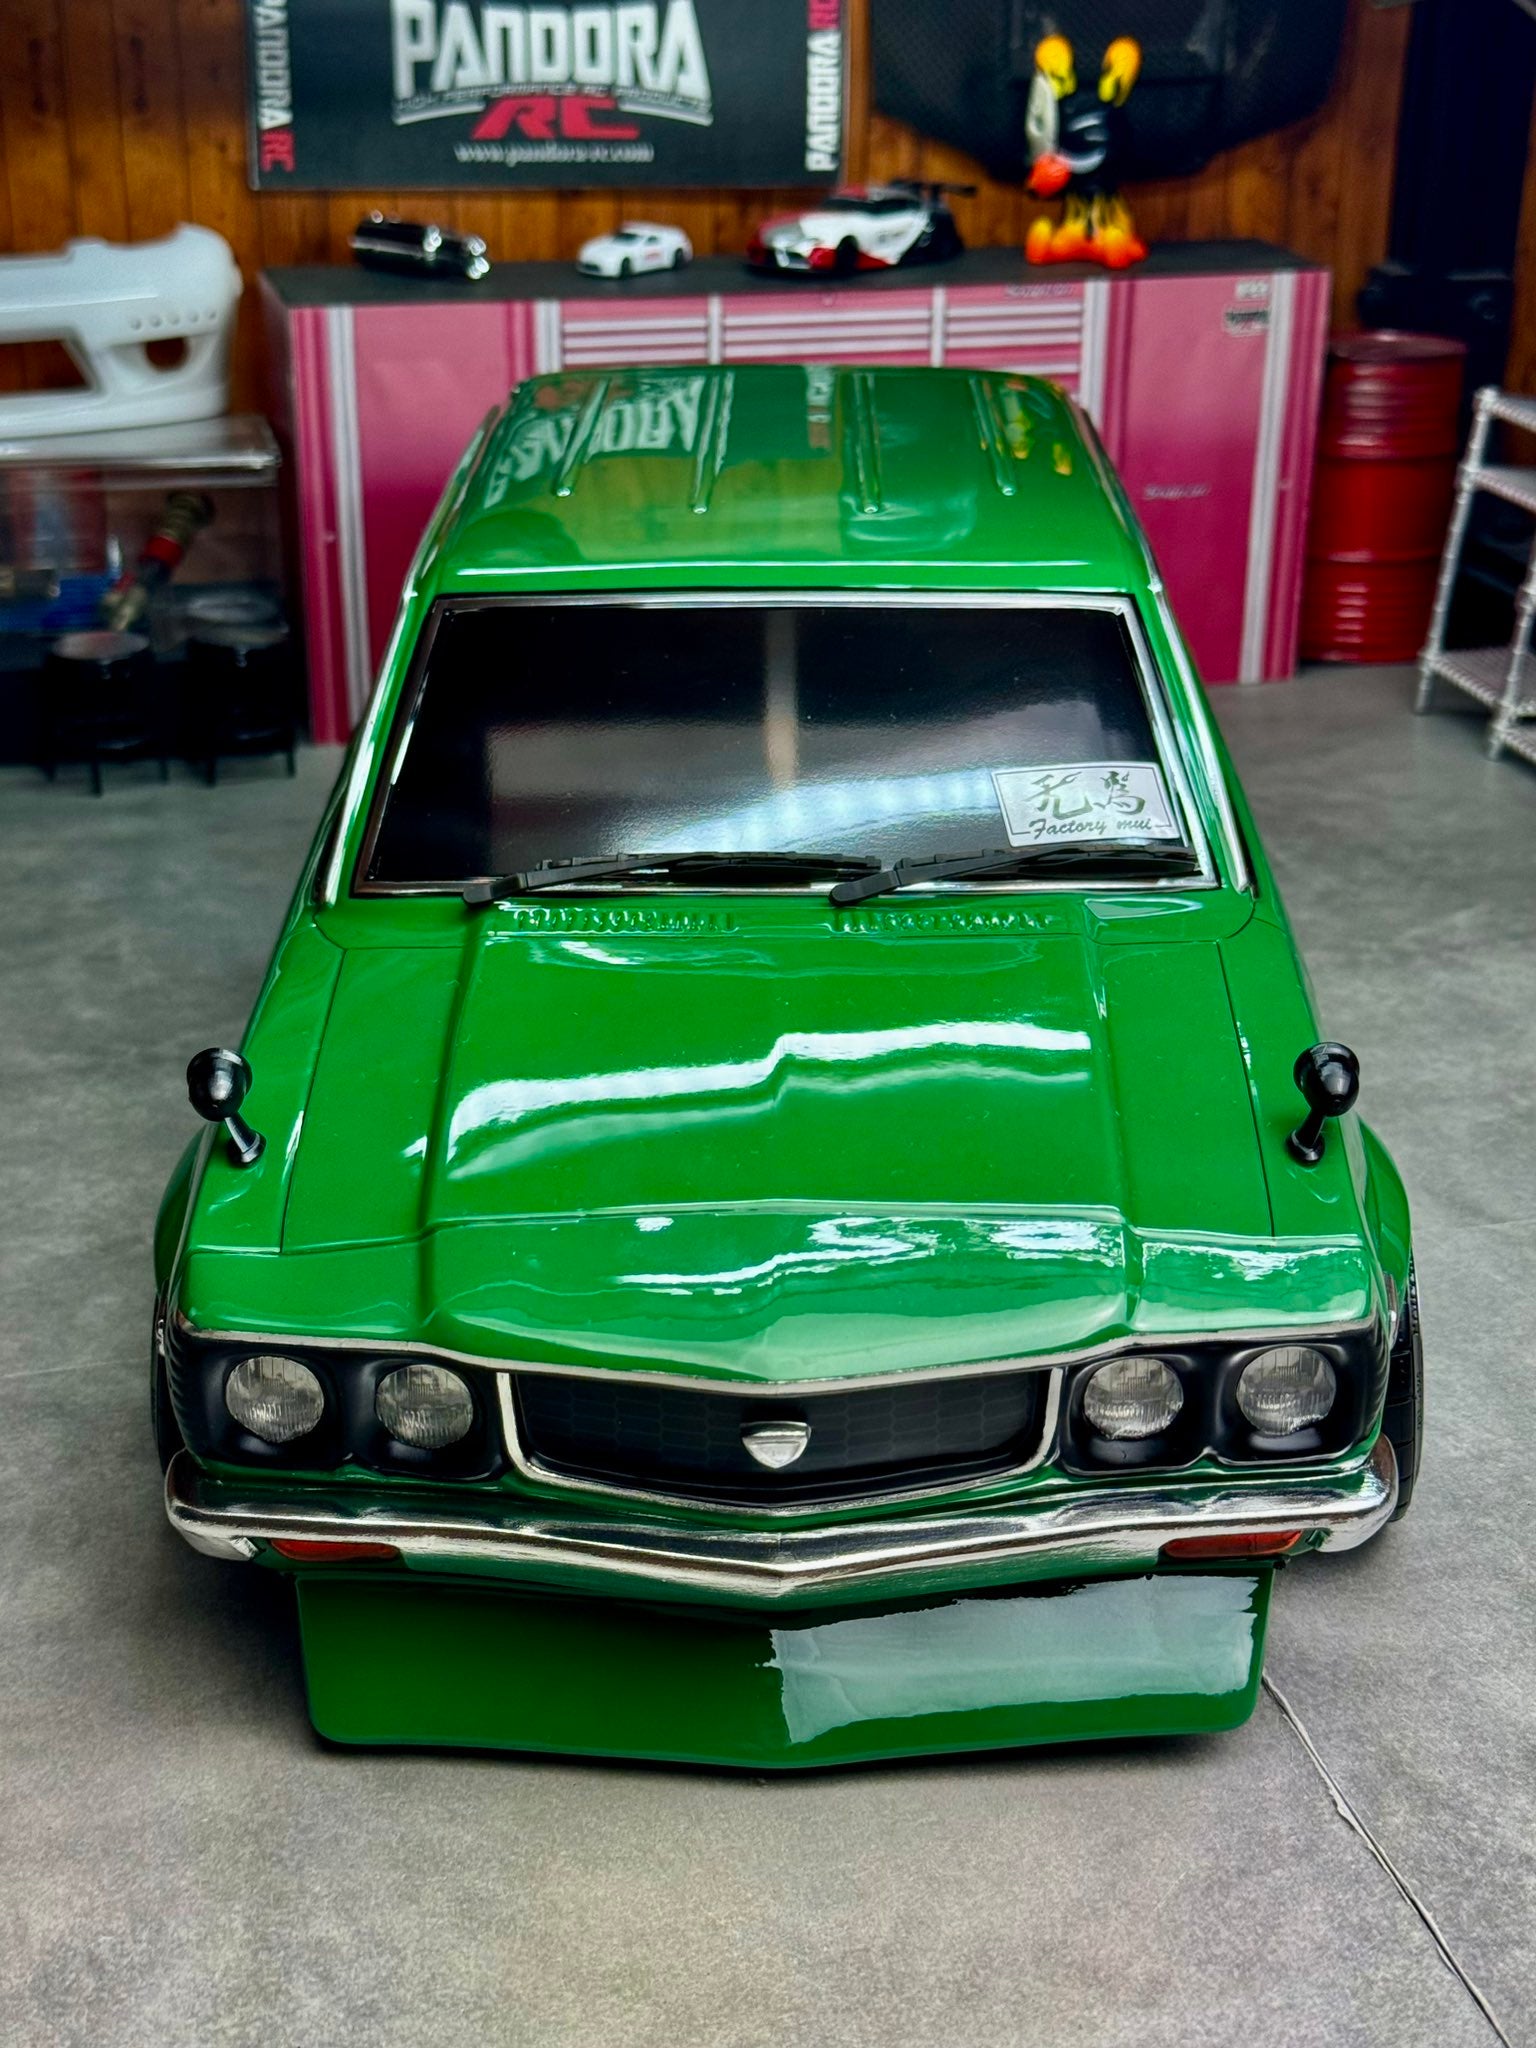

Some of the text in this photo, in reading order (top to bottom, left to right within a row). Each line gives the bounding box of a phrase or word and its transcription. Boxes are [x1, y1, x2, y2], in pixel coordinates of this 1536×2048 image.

[391, 0, 712, 99] PANDORA
[471, 95, 640, 139] RC
[805, 30, 841, 171] PANDORA
[1028, 817, 1153, 840] Factory mui
